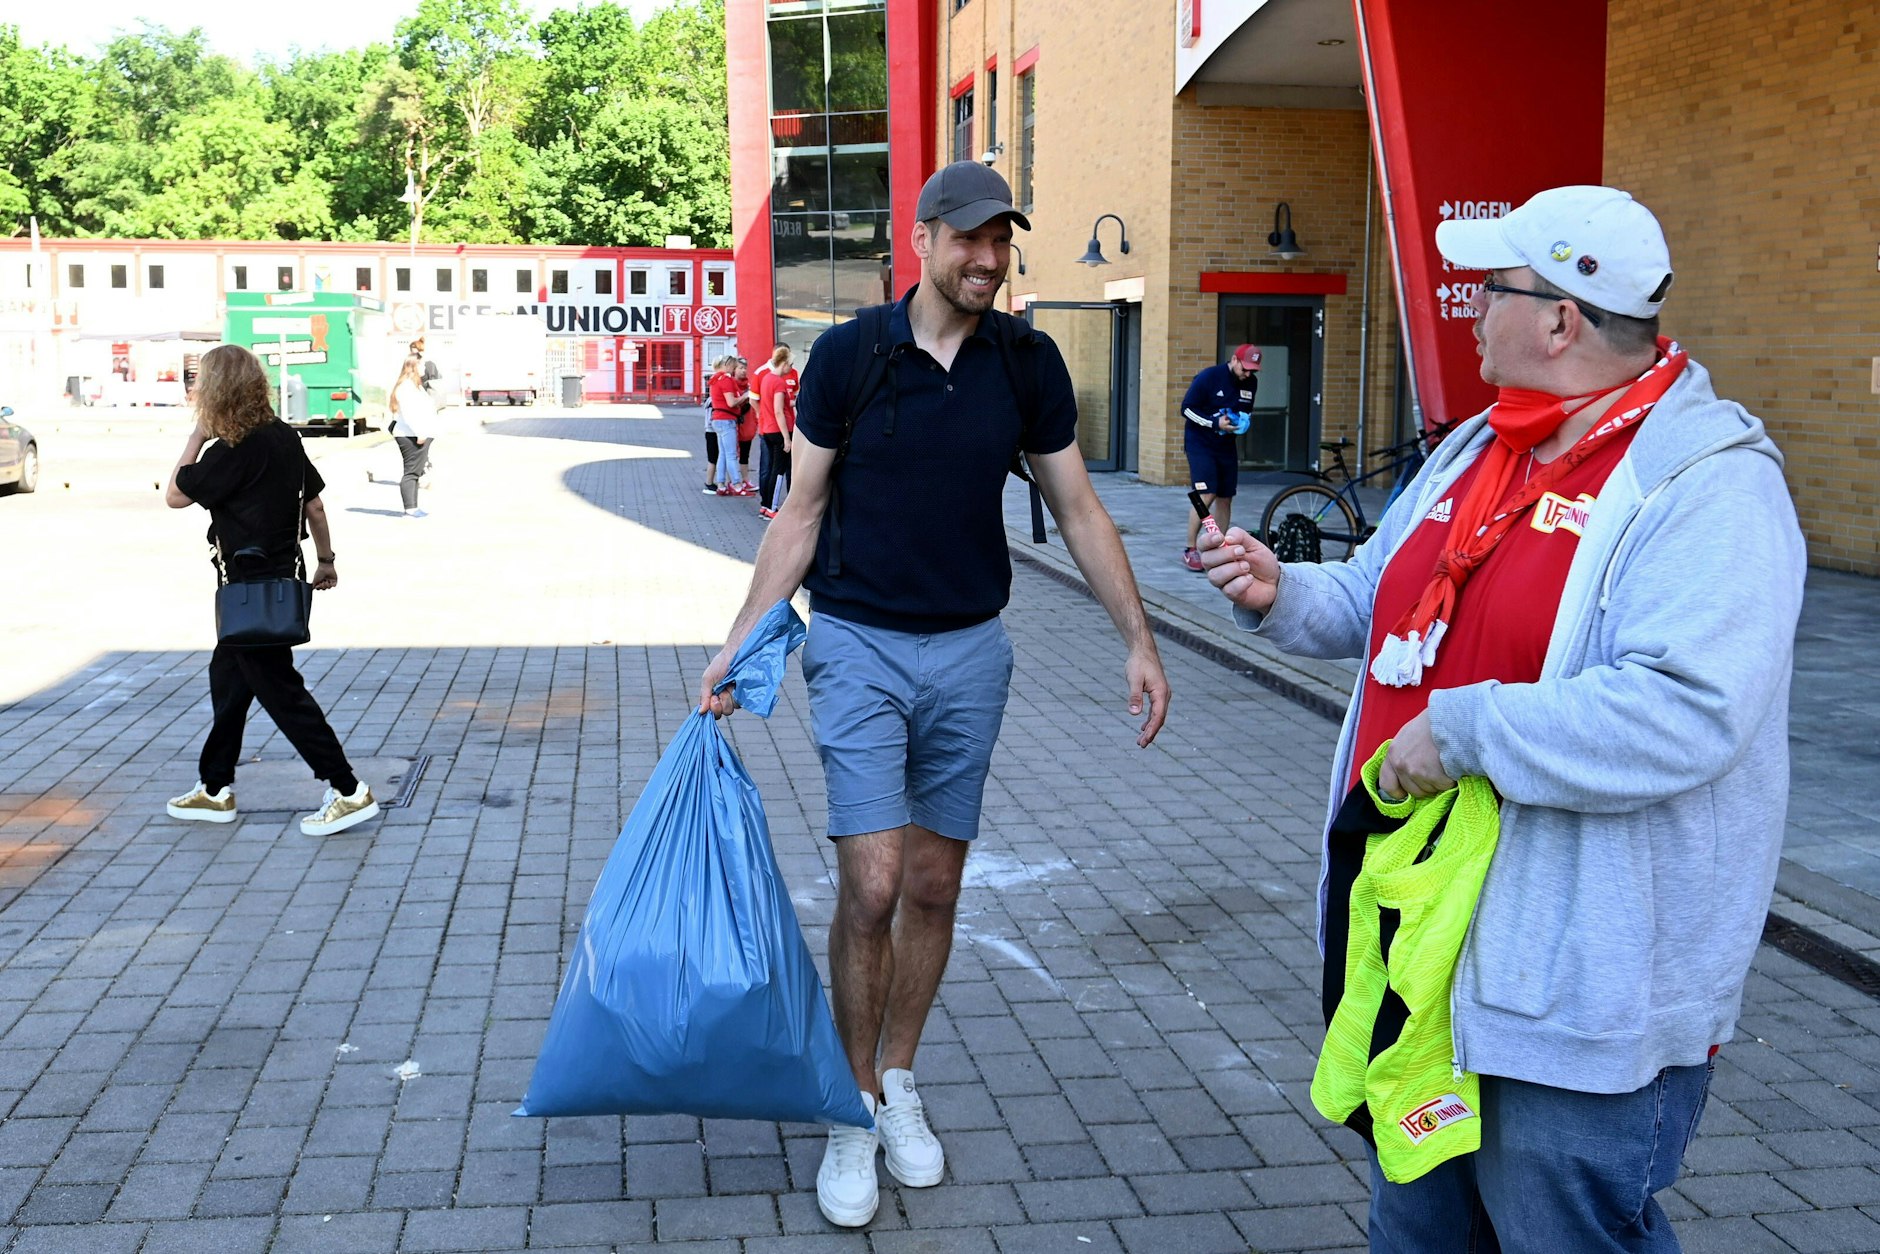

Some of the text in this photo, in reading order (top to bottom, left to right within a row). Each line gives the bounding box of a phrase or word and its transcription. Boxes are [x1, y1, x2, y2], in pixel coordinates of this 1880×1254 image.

[1454, 200, 1512, 220] LOGEN
[547, 304, 661, 333] UNION!
[1435, 1103, 1468, 1121] UNION
